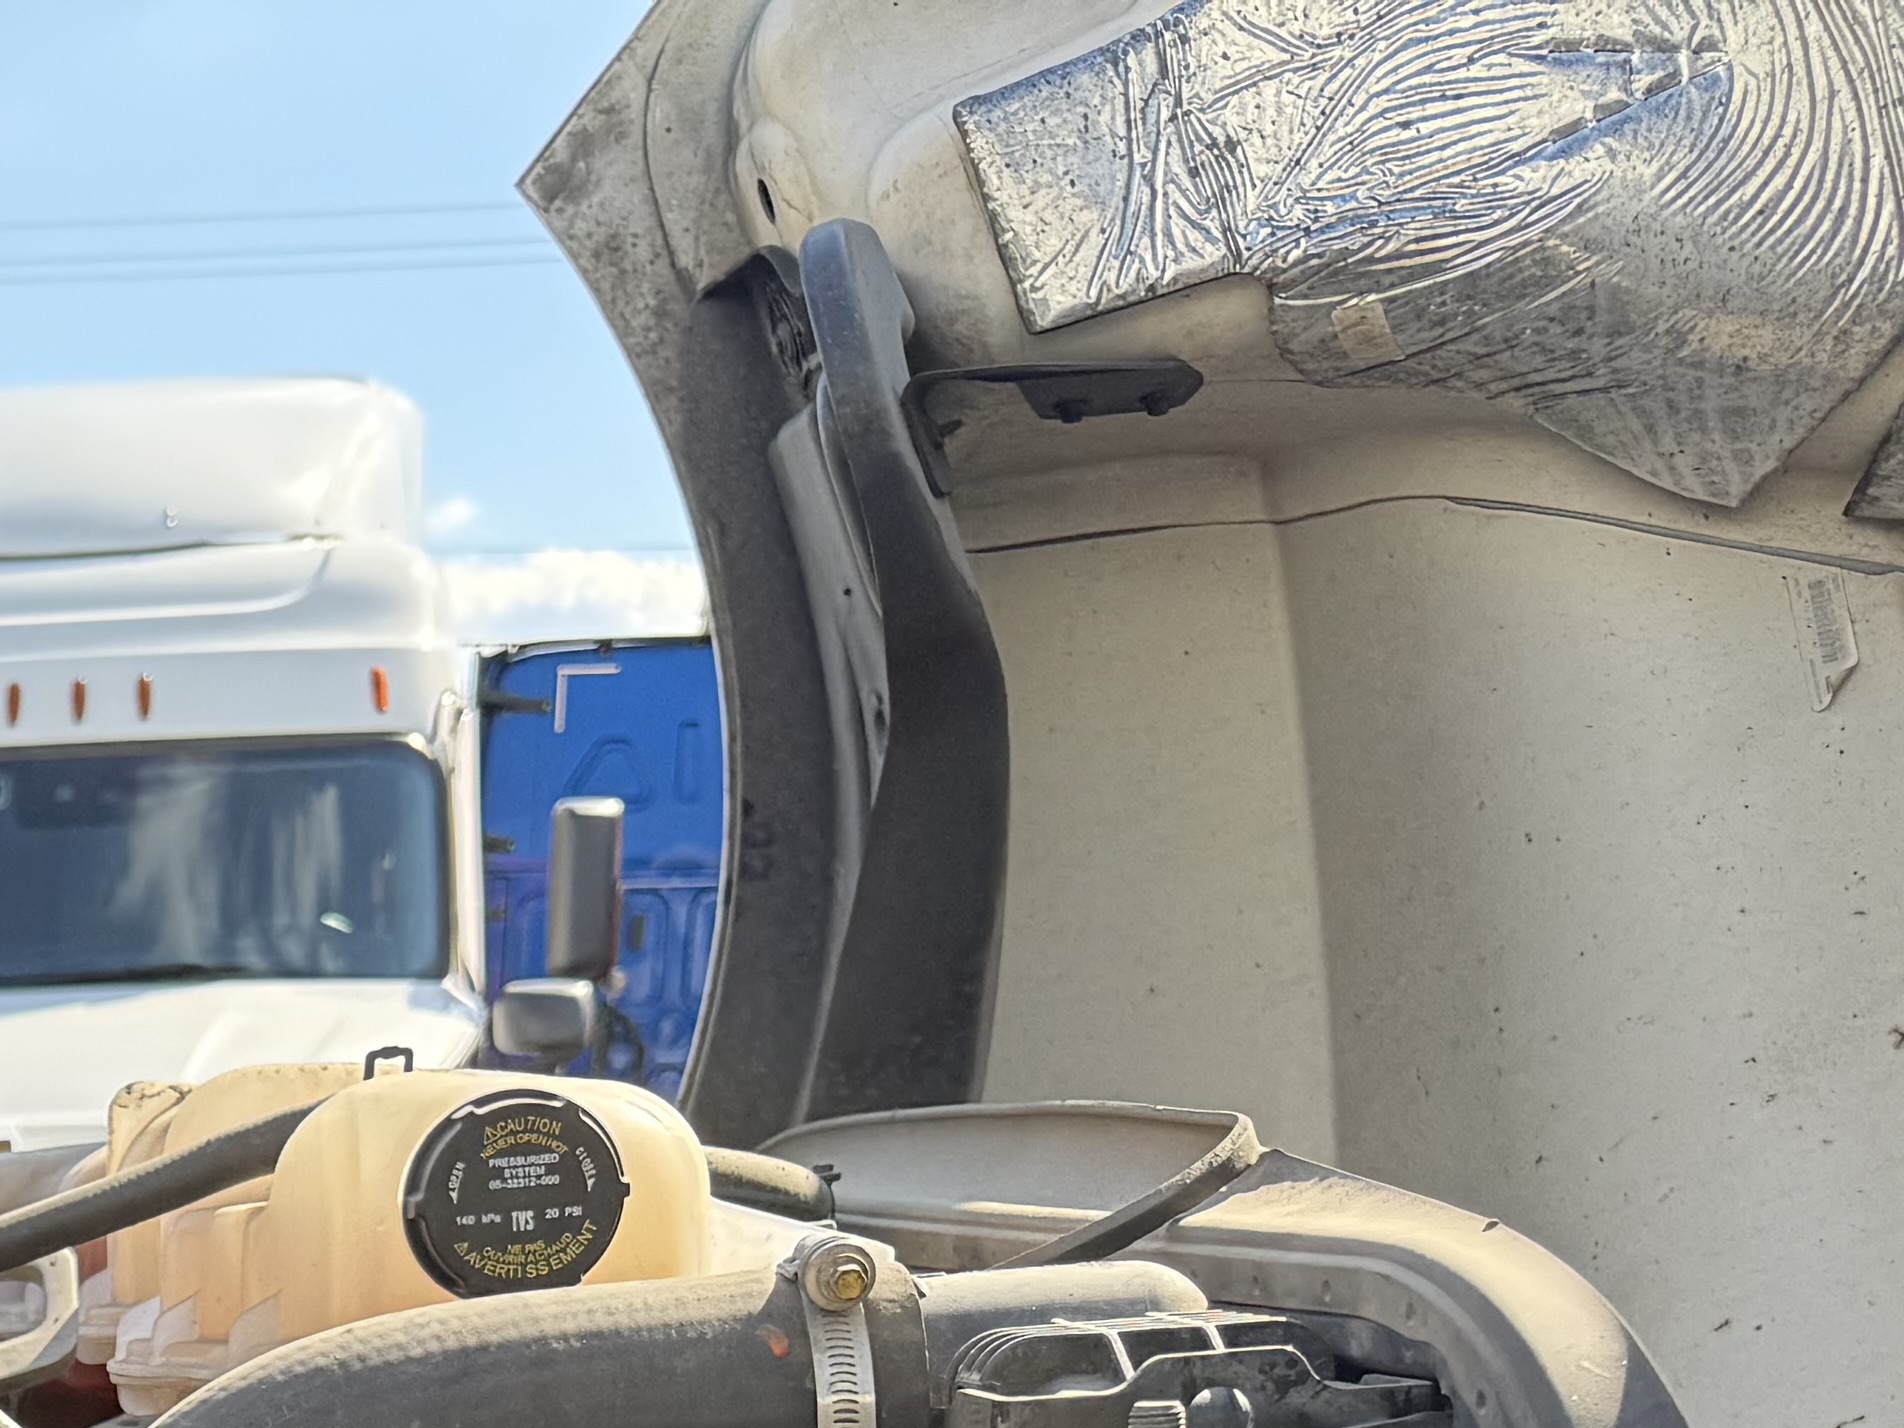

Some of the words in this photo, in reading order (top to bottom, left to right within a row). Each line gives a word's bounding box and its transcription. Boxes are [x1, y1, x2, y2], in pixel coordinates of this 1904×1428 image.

[497, 1115, 561, 1136] CAUTION
[488, 1153, 560, 1168] PRESSURIZED
[504, 1166, 546, 1179] SYSTEM
[511, 1210, 535, 1232] TVS
[544, 1208, 559, 1219] 20
